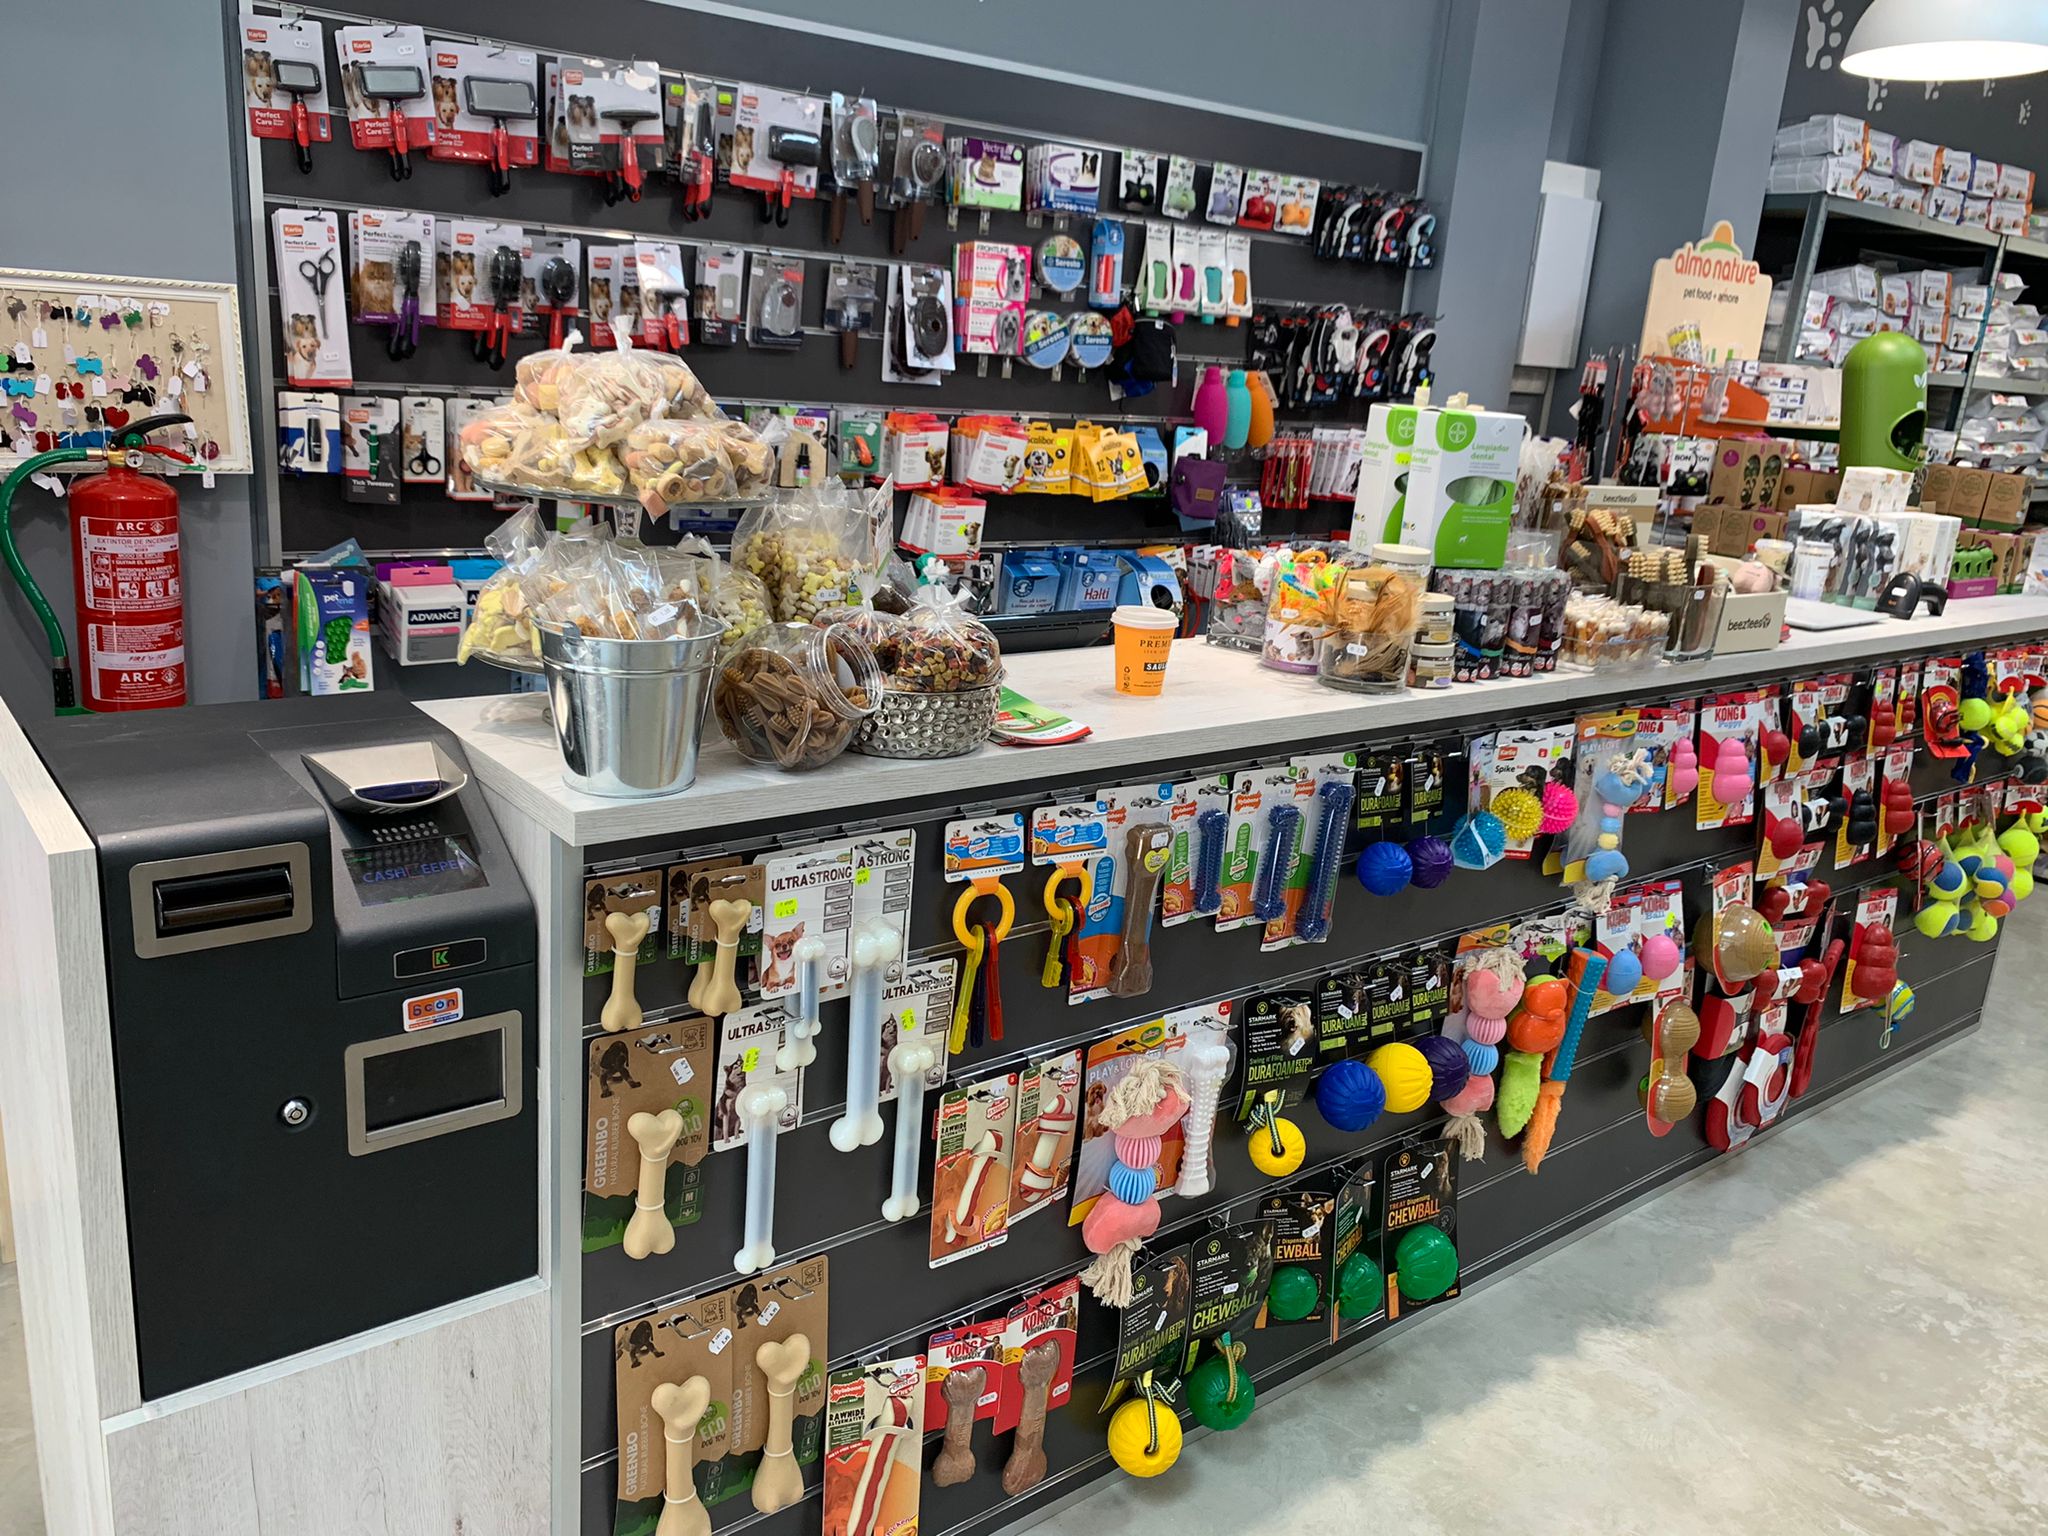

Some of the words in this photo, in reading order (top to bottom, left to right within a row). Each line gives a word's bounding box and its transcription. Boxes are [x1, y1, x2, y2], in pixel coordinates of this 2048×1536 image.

[255, 110, 281, 119] Perfect
[365, 121, 389, 129] Perfect
[572, 144, 593, 152] Perfect
[572, 151, 587, 159] Care
[1055, 258, 1081, 268] Seresto
[1675, 248, 1710, 279] almo
[1715, 255, 1758, 285] nature
[1683, 287, 1694, 299] pet
[1695, 287, 1713, 300] food
[1038, 331, 1065, 348] Seresto
[1085, 336, 1110, 345] Seresto
[793, 417, 815, 427] KONG
[1472, 443, 1510, 453] Limpiador
[1471, 453, 1495, 461] dental
[1674, 454, 1692, 463] BON
[352, 479, 365, 487] Tick
[366, 480, 395, 488] Tweezers
[116, 522, 145, 531] ARC
[1084, 588, 1111, 600] Halti
[410, 611, 460, 623] ADVANCE
[121, 671, 155, 682] ARC
[1715, 706, 1739, 722] KONG
[1637, 720, 1657, 732] ONG
[1494, 764, 1516, 774] Spike
[1160, 788, 1170, 796] XL
[856, 849, 911, 869] ASTRONG
[362, 858, 473, 883] CASHEEPER
[771, 866, 853, 892] ULTRASTRONG
[1641, 896, 1669, 915] KONG
[1606, 909, 1631, 930] KONG
[1646, 910, 1665, 920] Ball
[1611, 925, 1627, 934] Ball
[690, 925, 699, 961] GREENBO
[587, 934, 595, 973] GREENBO
[1412, 988, 1444, 1007] DURAFOAM
[1372, 1000, 1405, 1020] DURAFOAM
[1248, 1014, 1277, 1023] STARMARK
[1321, 1013, 1364, 1034] DURAFOAM
[727, 1013, 786, 1041] ULTRASTR
[1295, 1057, 1313, 1067] FETCH
[1248, 1060, 1295, 1082] DURAFOAM
[612, 1096, 621, 1118] BONE
[941, 1121, 967, 1134] RAWHIDE
[675, 1137, 689, 1148] DOG
[689, 1134, 703, 1146] TOY
[593, 1116, 609, 1189] GREENBO
[1390, 1164, 1418, 1178] STARMARK
[1387, 1197, 1441, 1228] CHEWBALL
[1276, 1243, 1322, 1260] EWBALL
[1196, 1251, 1230, 1268] STARMARK
[1192, 1290, 1258, 1331] CHEWBALL
[1022, 1305, 1055, 1333] KONG
[945, 1340, 979, 1358] KONG
[1119, 1328, 1170, 1372] DURAFOAM
[798, 1374, 822, 1396] ECO
[798, 1392, 811, 1404] DOG
[731, 1388, 743, 1449] GREENBO
[828, 1415, 865, 1427] ALTERNATIVE
[829, 1408, 865, 1421] RAWHIDE
[699, 1419, 727, 1440] ECO
[701, 1436, 716, 1449] DOG
[625, 1431, 638, 1496] GREENBO
